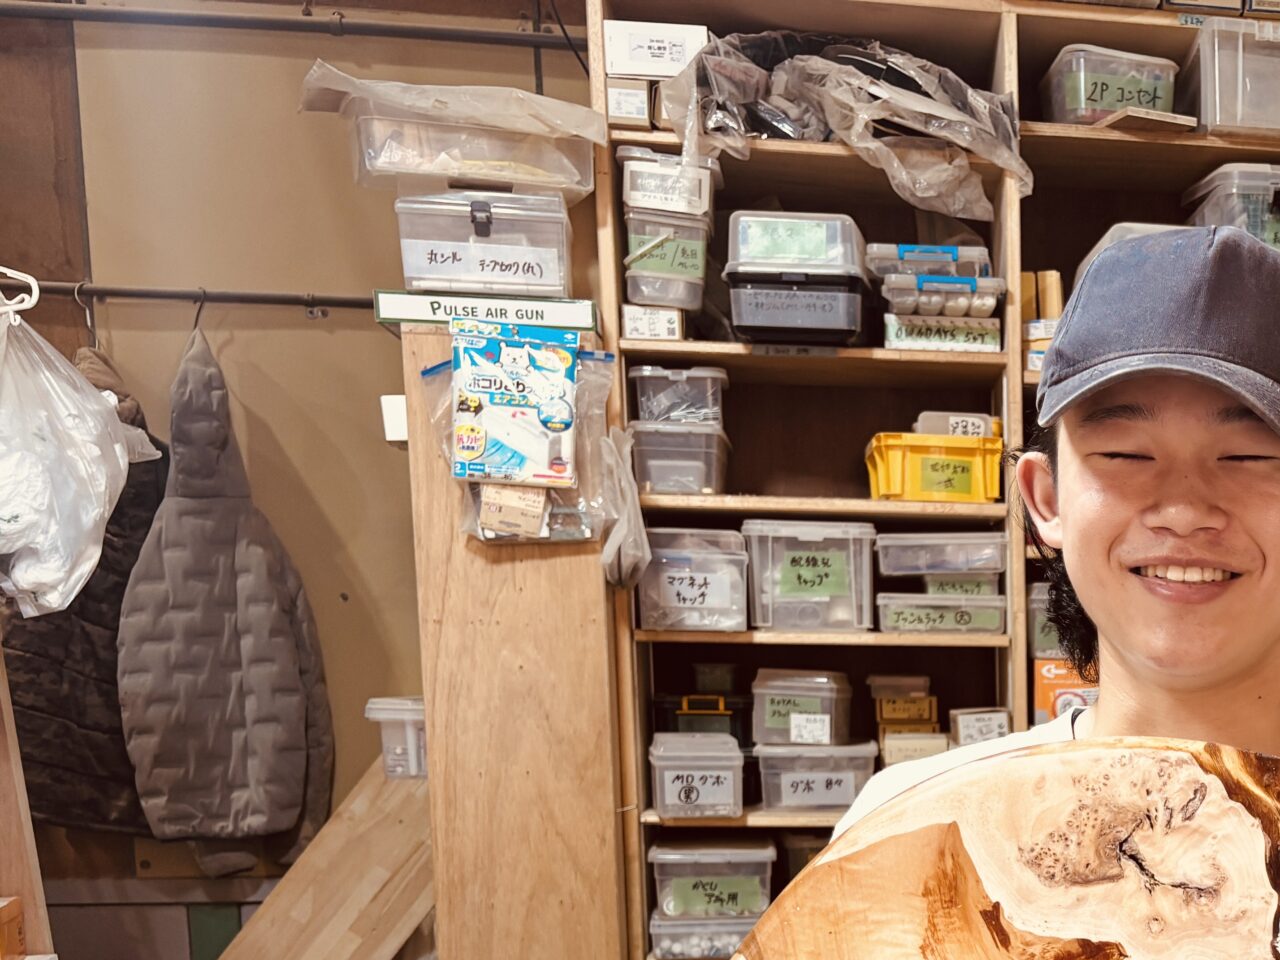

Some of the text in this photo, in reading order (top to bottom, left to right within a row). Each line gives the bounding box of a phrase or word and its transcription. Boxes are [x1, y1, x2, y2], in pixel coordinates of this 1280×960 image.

[1087, 81, 1109, 102] 2P
[429, 300, 545, 321] PULSE AIR GUN
[667, 575, 711, 590] マグネット
[676, 591, 708, 605] キャッチ
